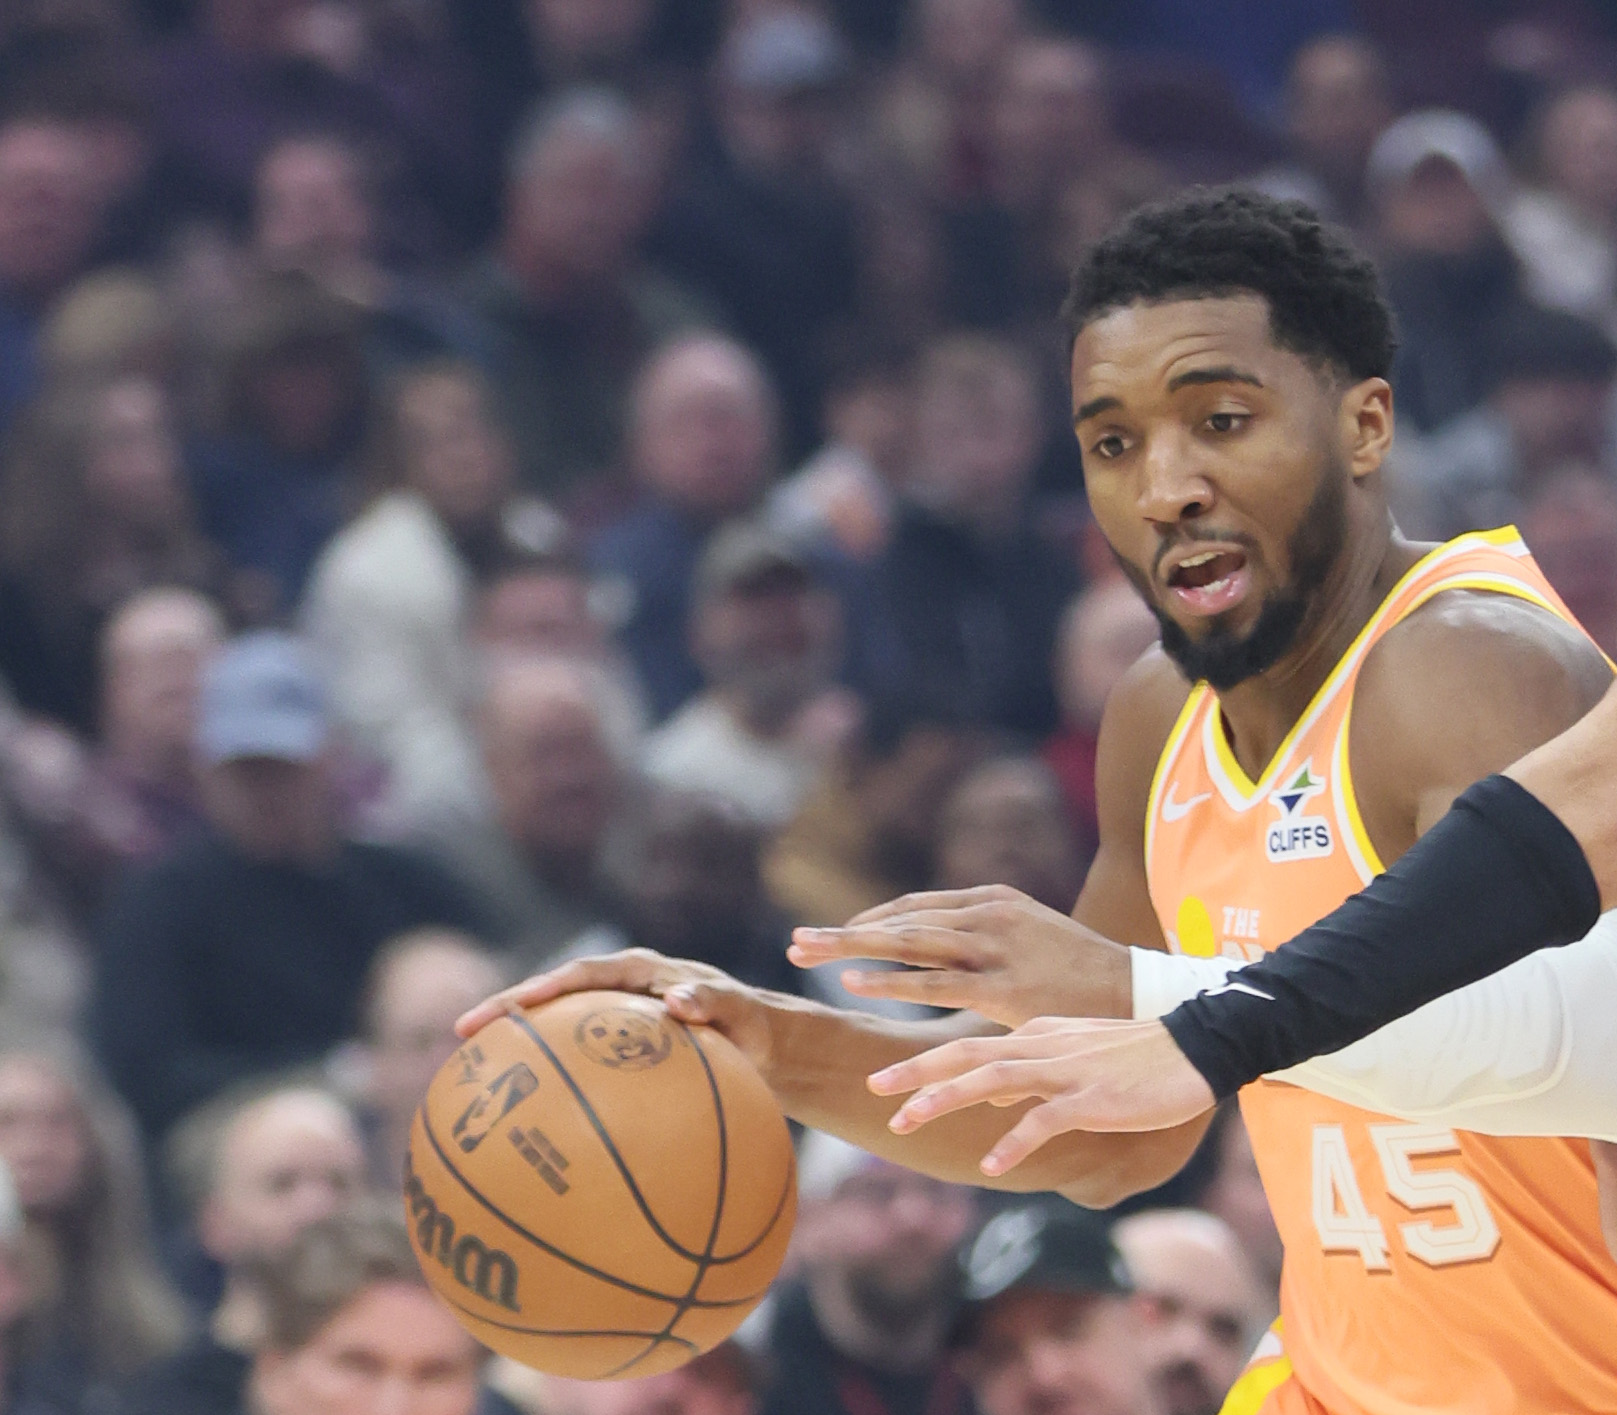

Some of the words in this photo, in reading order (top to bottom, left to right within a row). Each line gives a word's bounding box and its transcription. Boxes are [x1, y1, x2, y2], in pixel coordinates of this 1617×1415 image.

[1269, 825, 1330, 853] CLIFFS
[1222, 906, 1260, 938] THE
[1311, 1122, 1502, 1275] 45
